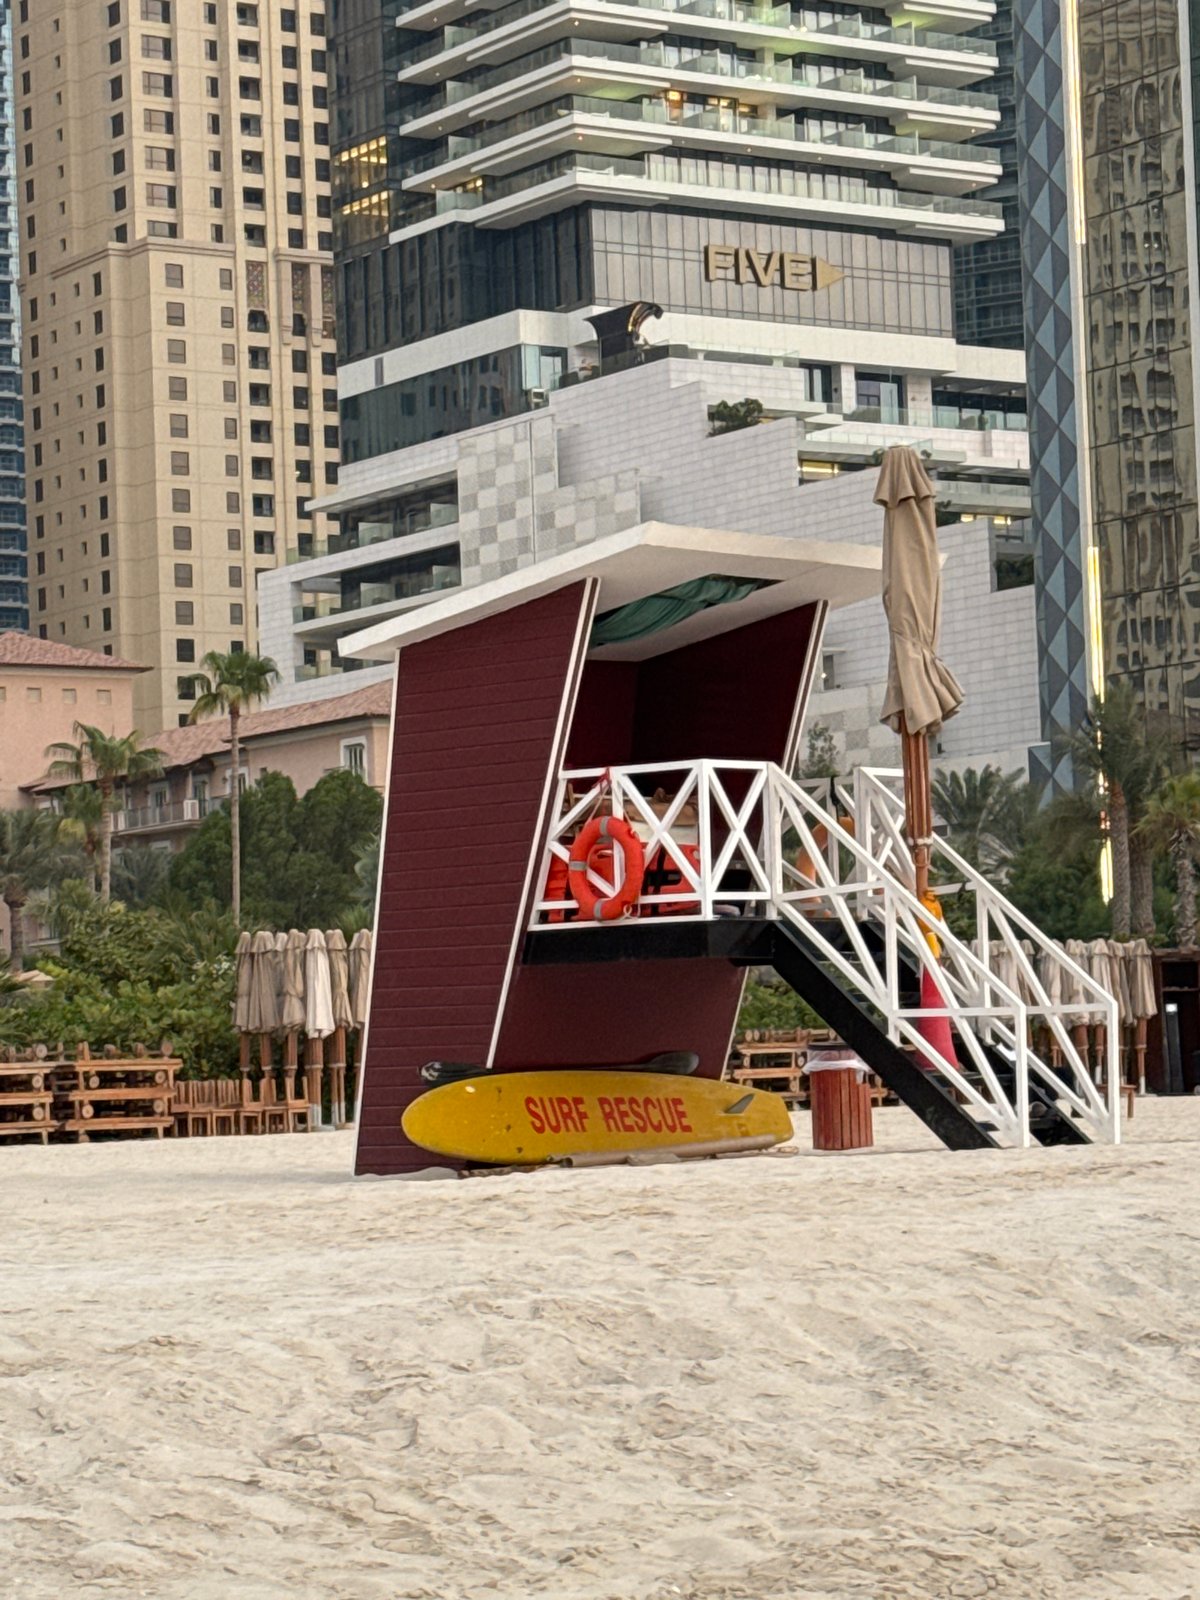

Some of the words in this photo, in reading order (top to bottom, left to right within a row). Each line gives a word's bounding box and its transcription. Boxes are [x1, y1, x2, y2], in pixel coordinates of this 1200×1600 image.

[704, 245, 812, 291] FIVE
[525, 1096, 589, 1134] SURF
[599, 1097, 692, 1133] RESCUE
